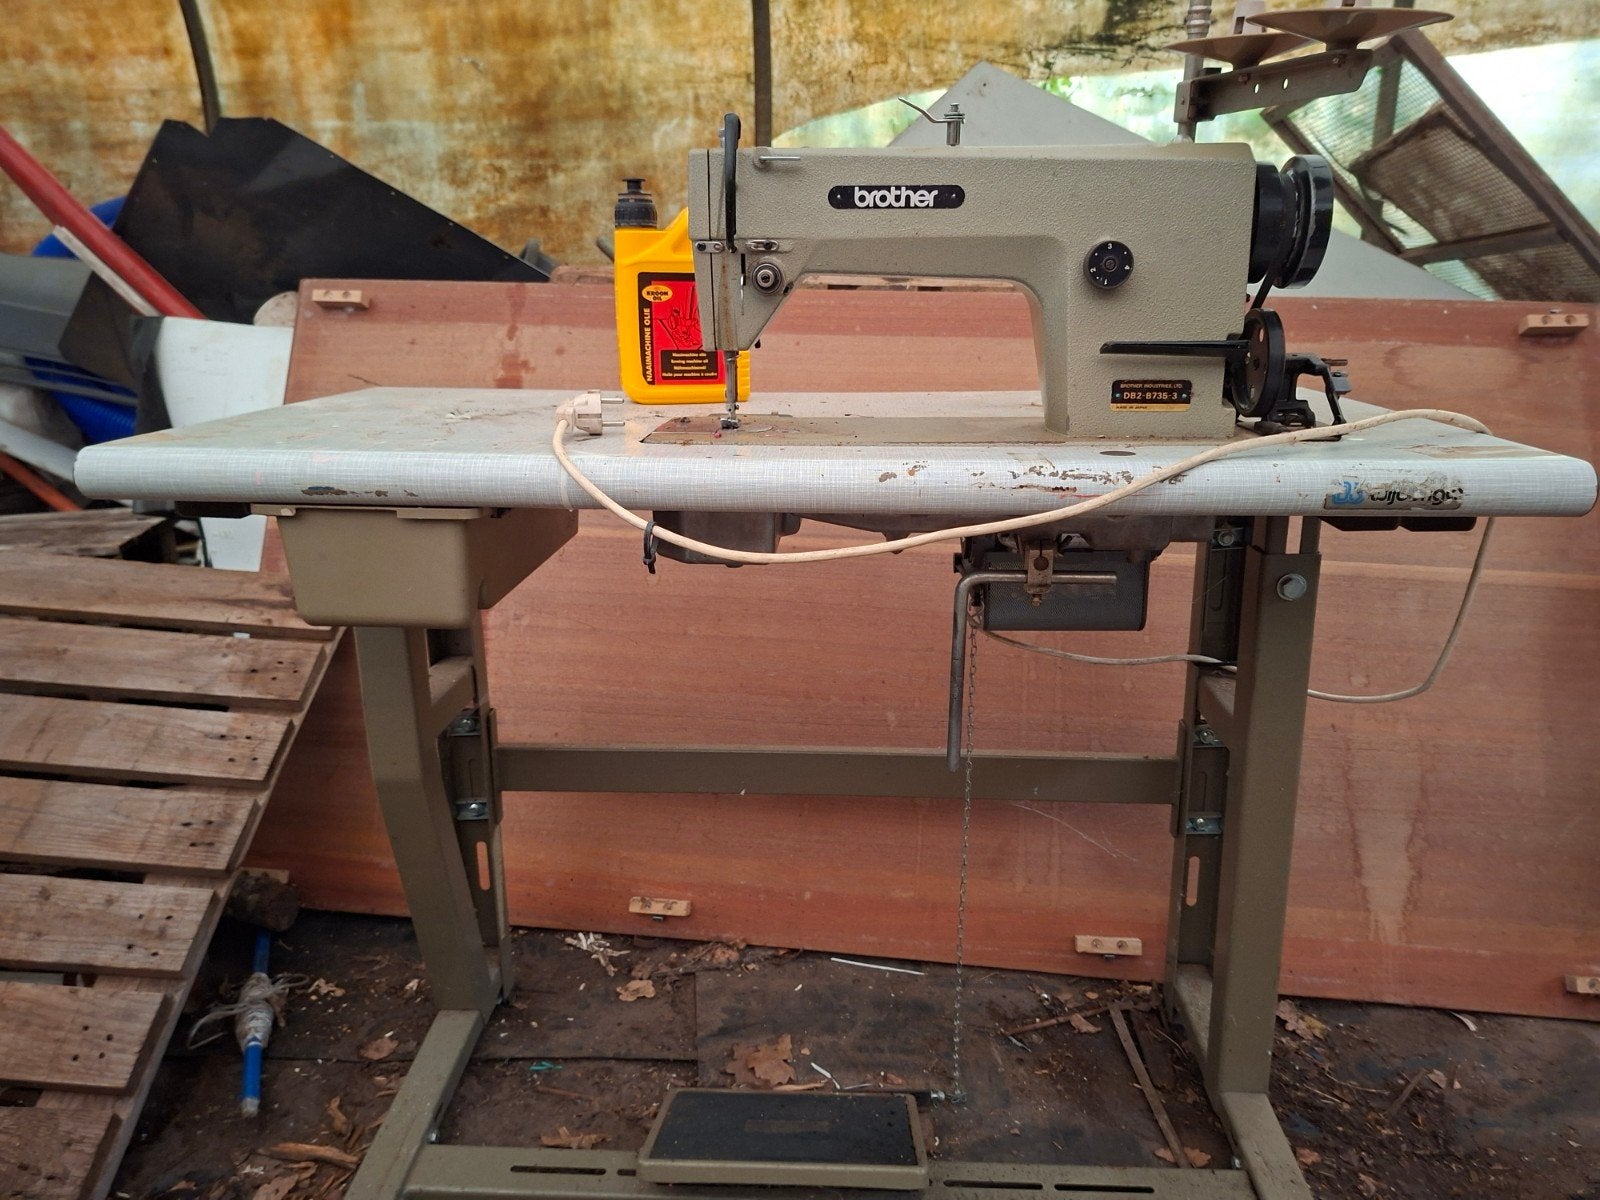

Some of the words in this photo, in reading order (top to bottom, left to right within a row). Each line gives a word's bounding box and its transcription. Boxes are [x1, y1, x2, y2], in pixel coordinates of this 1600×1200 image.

[854, 186, 938, 208] brother
[643, 308, 651, 326] OLIE
[643, 327, 653, 382] NAAIMACHINE
